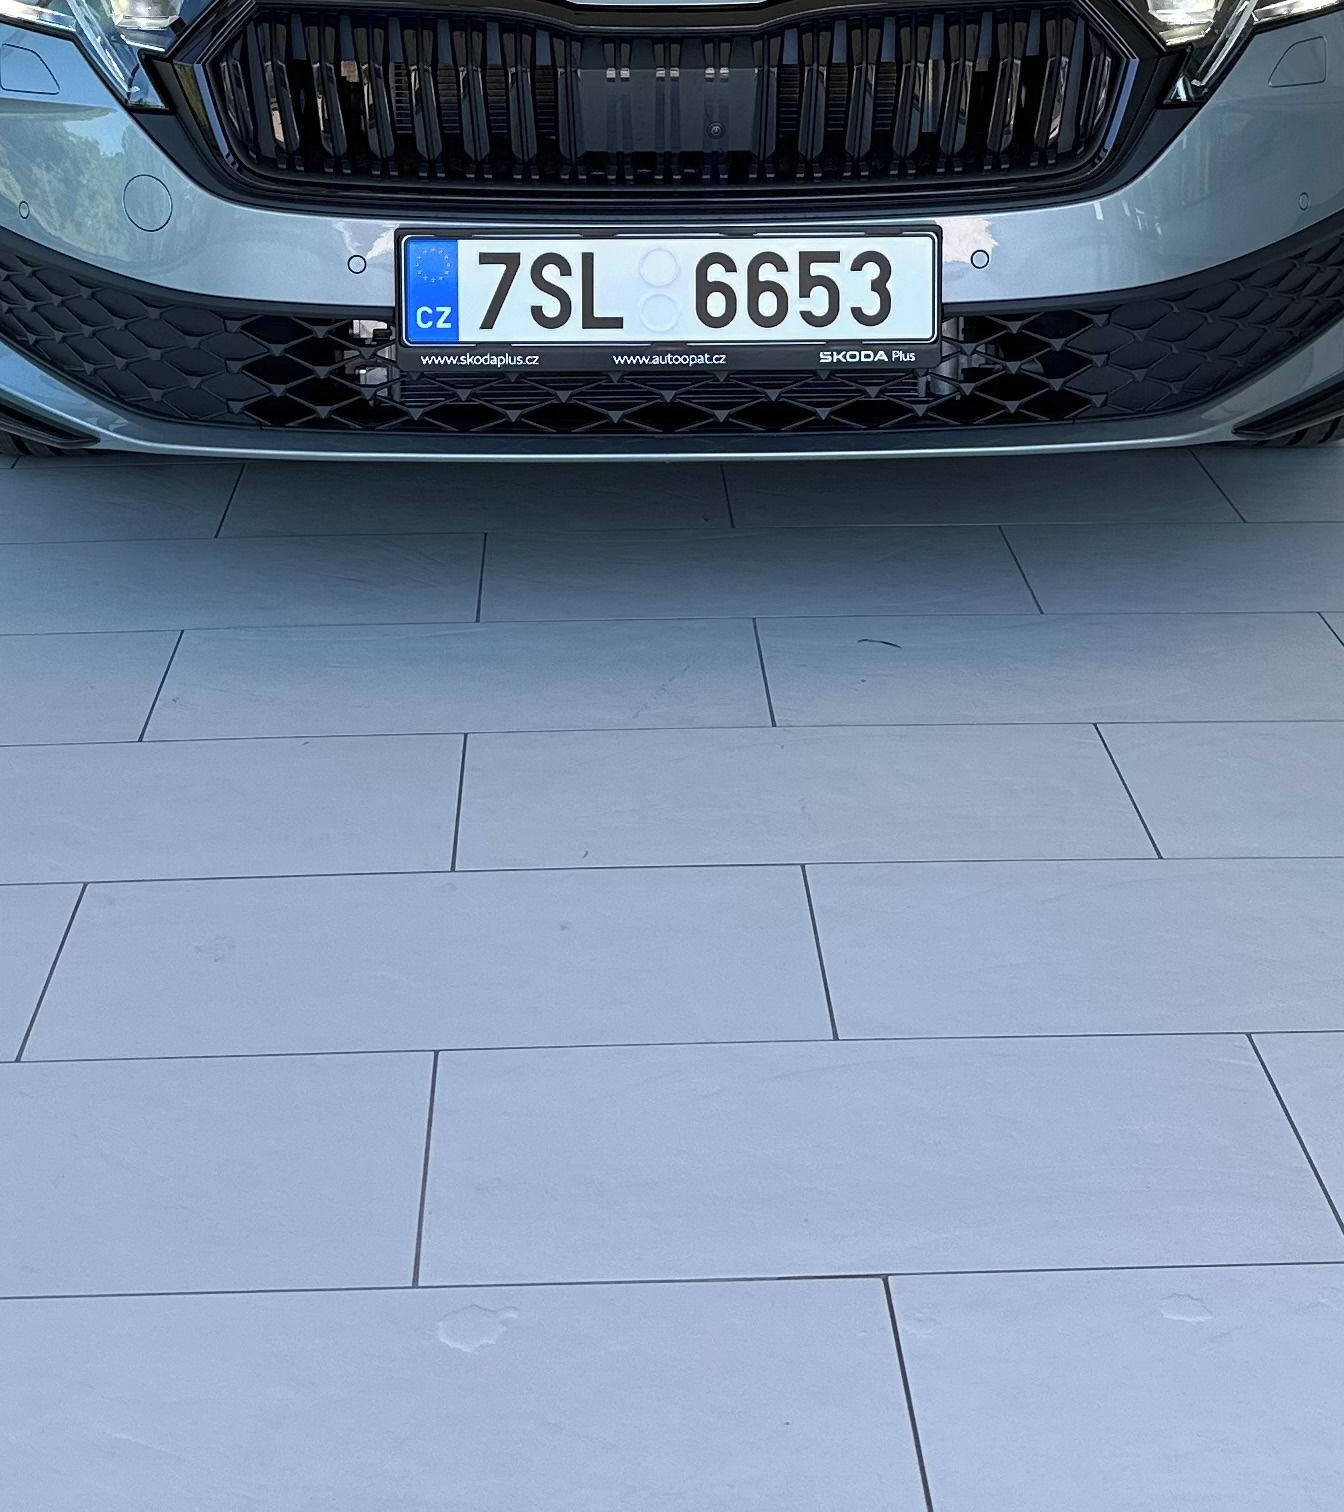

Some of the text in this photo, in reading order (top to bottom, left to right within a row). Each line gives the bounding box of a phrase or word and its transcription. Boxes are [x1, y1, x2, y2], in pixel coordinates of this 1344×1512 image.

[478, 251, 892, 330] 7SL 6653
[416, 305, 452, 329] CZ
[420, 353, 540, 368] www.skodaplus.cz
[612, 353, 727, 366] www.autoopat.cz
[891, 350, 916, 362] Plus
